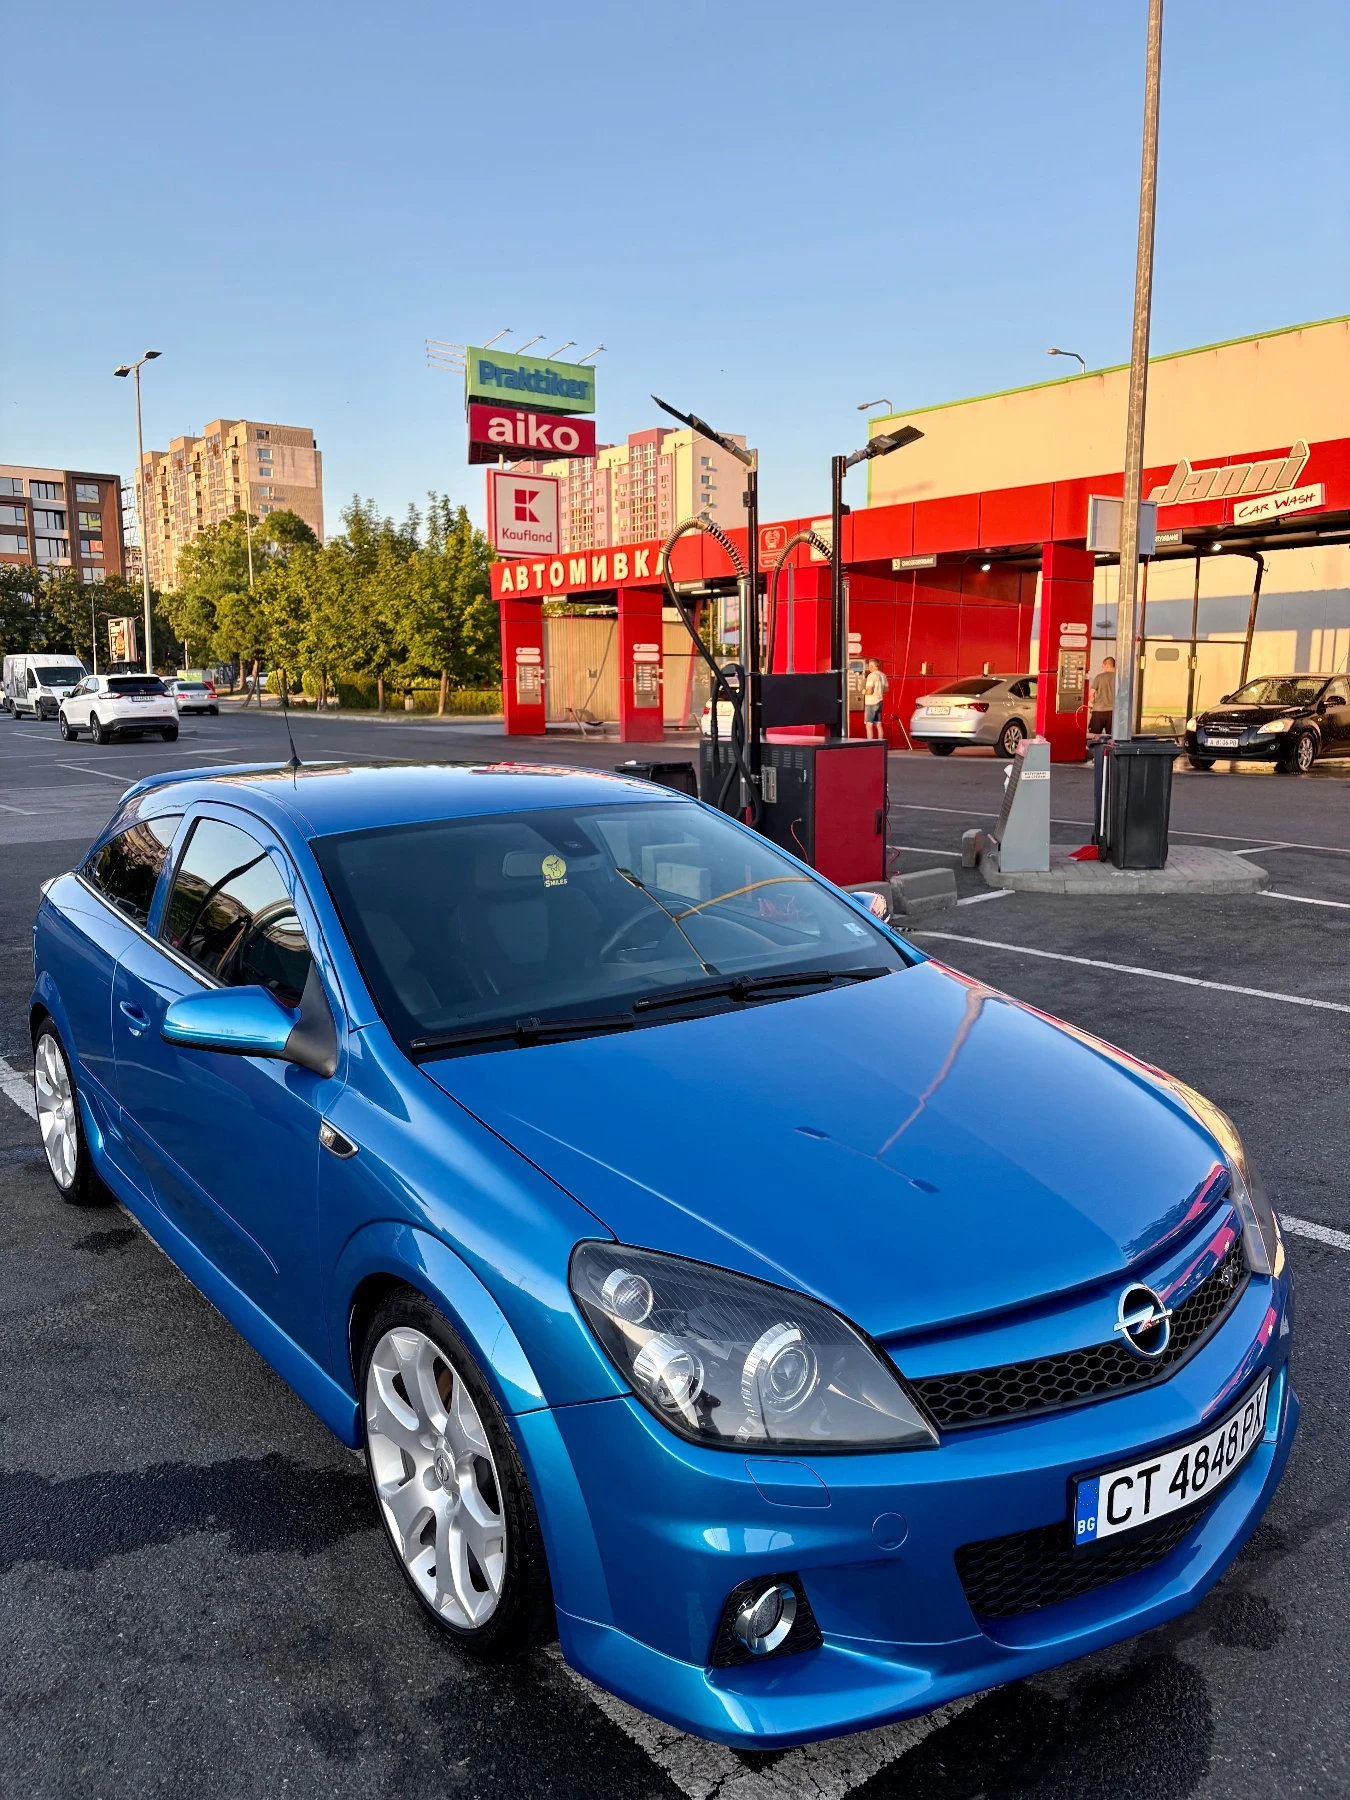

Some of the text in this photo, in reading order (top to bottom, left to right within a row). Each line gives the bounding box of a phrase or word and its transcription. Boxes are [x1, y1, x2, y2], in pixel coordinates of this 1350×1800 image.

[478, 359, 589, 400] Praktiker
[487, 412, 580, 451] aiko
[1238, 491, 1316, 519] CAR WASH
[501, 527, 553, 543] Kaufland
[500, 549, 674, 593] АВТОМИВКА
[1077, 1385, 1267, 1535] BG CT 4848 PX
